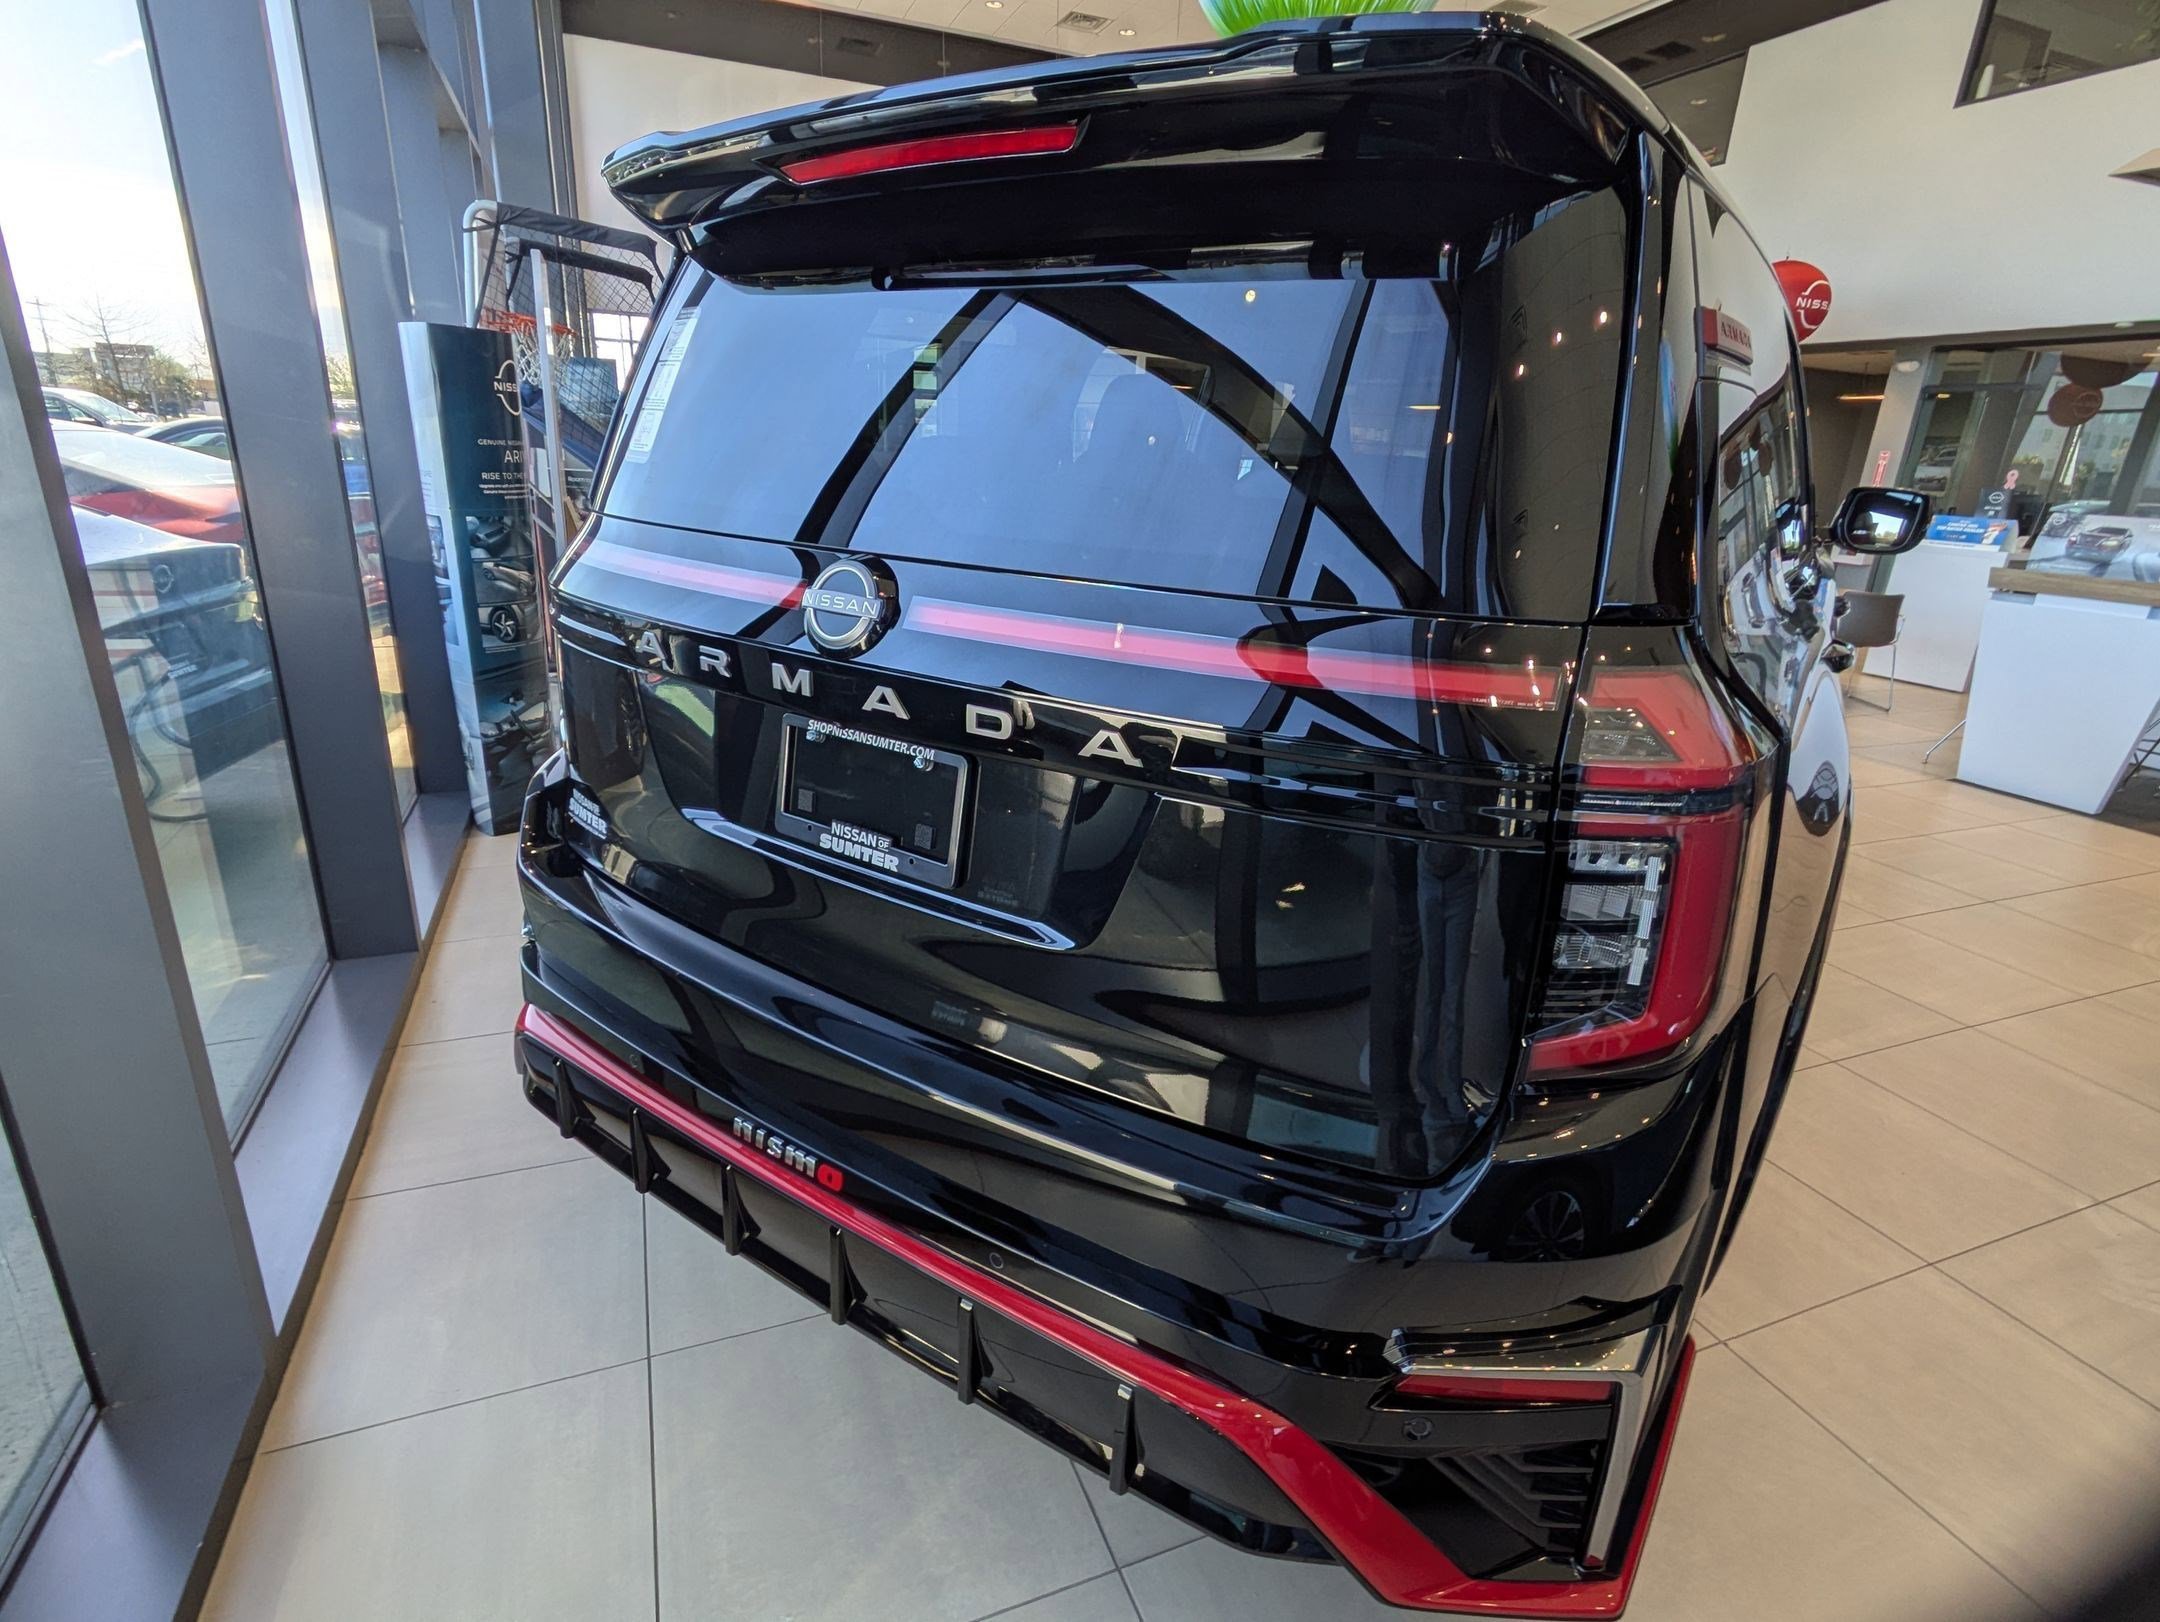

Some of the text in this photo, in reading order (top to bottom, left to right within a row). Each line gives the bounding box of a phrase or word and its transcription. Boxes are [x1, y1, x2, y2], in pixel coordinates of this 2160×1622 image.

[1796, 297, 1829, 310] NISS
[494, 382, 518, 392] NISS
[504, 450, 523, 463] ARI
[481, 472, 501, 480] RISE
[502, 472, 512, 480] TO
[804, 592, 877, 615] NISSAN
[635, 630, 1144, 768] ARMADA
[807, 719, 935, 760] SHOPNISSANSUMTER.COM
[831, 821, 889, 849] NISSAN OF
[819, 832, 900, 873] SUMTER
[732, 1116, 844, 1192] nismo
